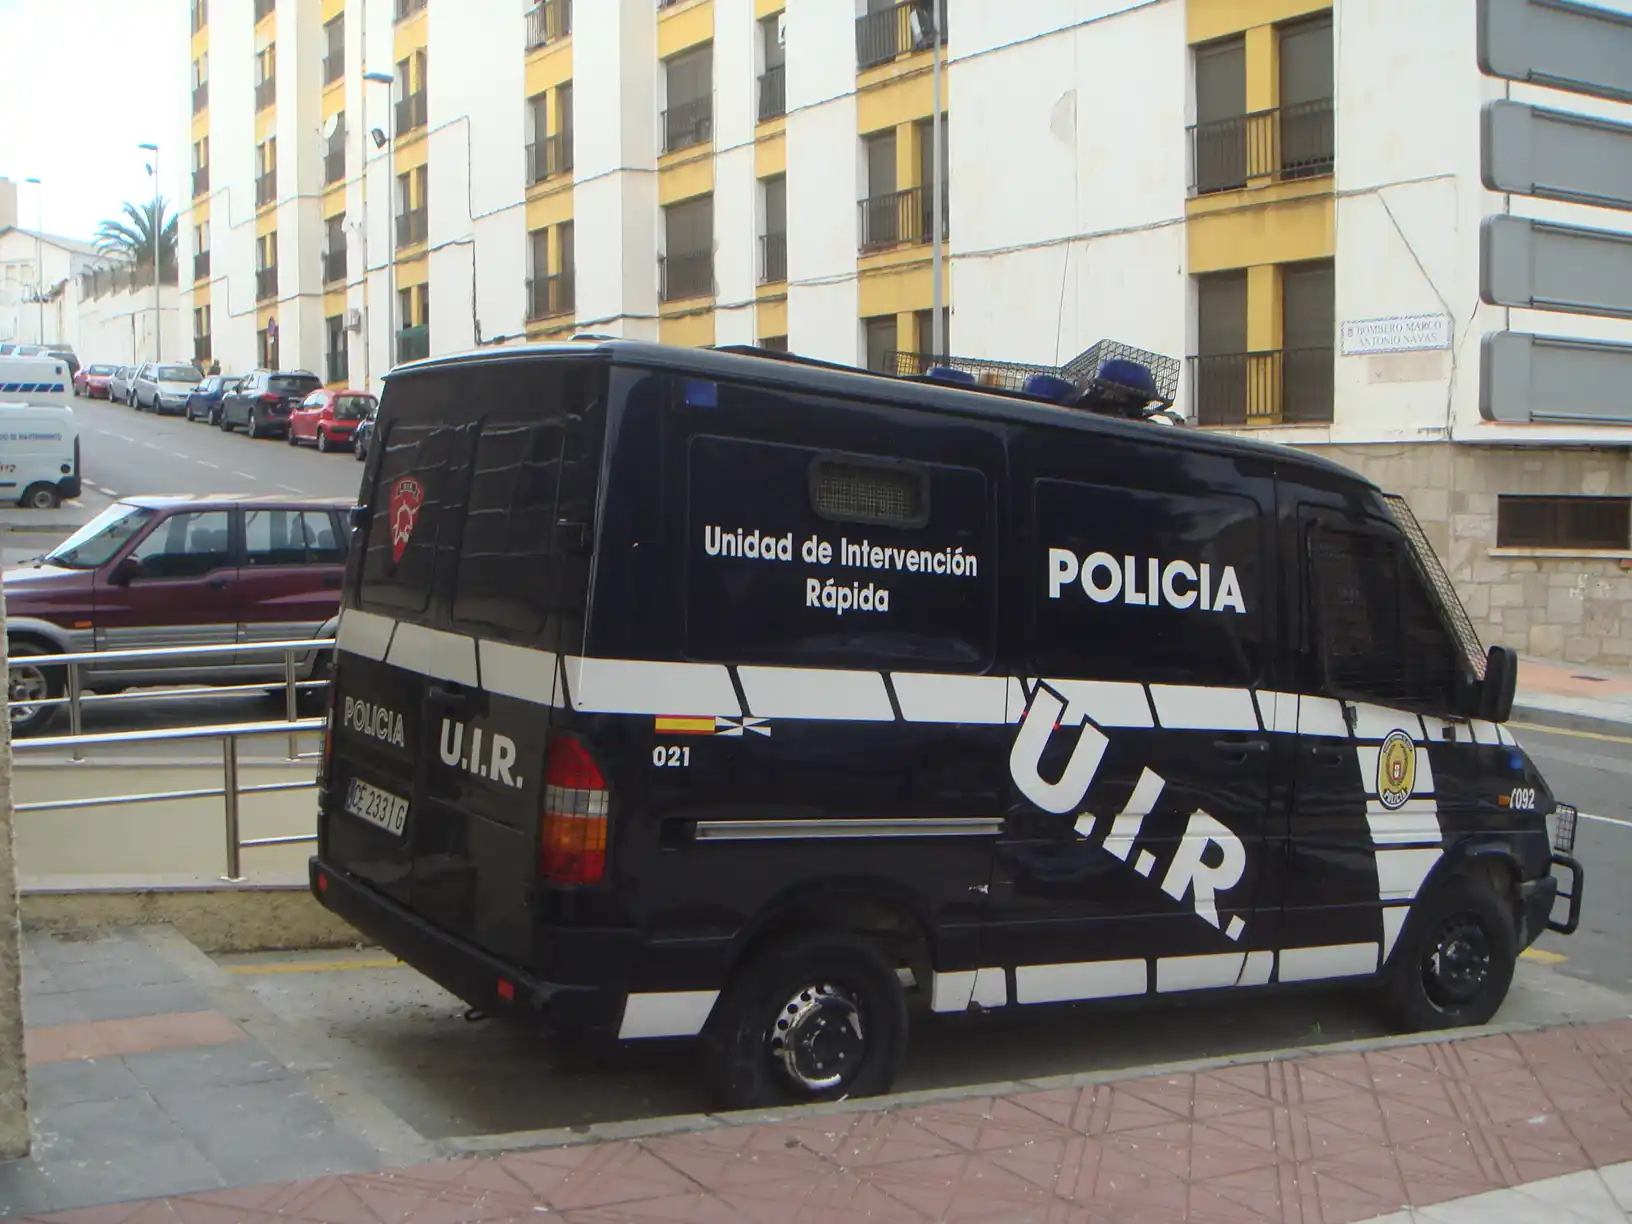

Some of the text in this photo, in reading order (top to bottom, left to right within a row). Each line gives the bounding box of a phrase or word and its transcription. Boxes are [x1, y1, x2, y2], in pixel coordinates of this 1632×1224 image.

[1356, 321, 1442, 335] BOMBERO MARCO
[1359, 333, 1438, 347] ANTONIO NAVAS
[704, 525, 978, 577] Unidad de Intervención
[806, 577, 889, 615] Rápida
[1048, 547, 1247, 614] POLICIA
[344, 696, 405, 748] POLICIA
[440, 718, 524, 789] U.I.R.
[652, 746, 690, 767] 021
[1009, 685, 1247, 942] U.I.R.
[1383, 789, 1408, 804] POLICIA
